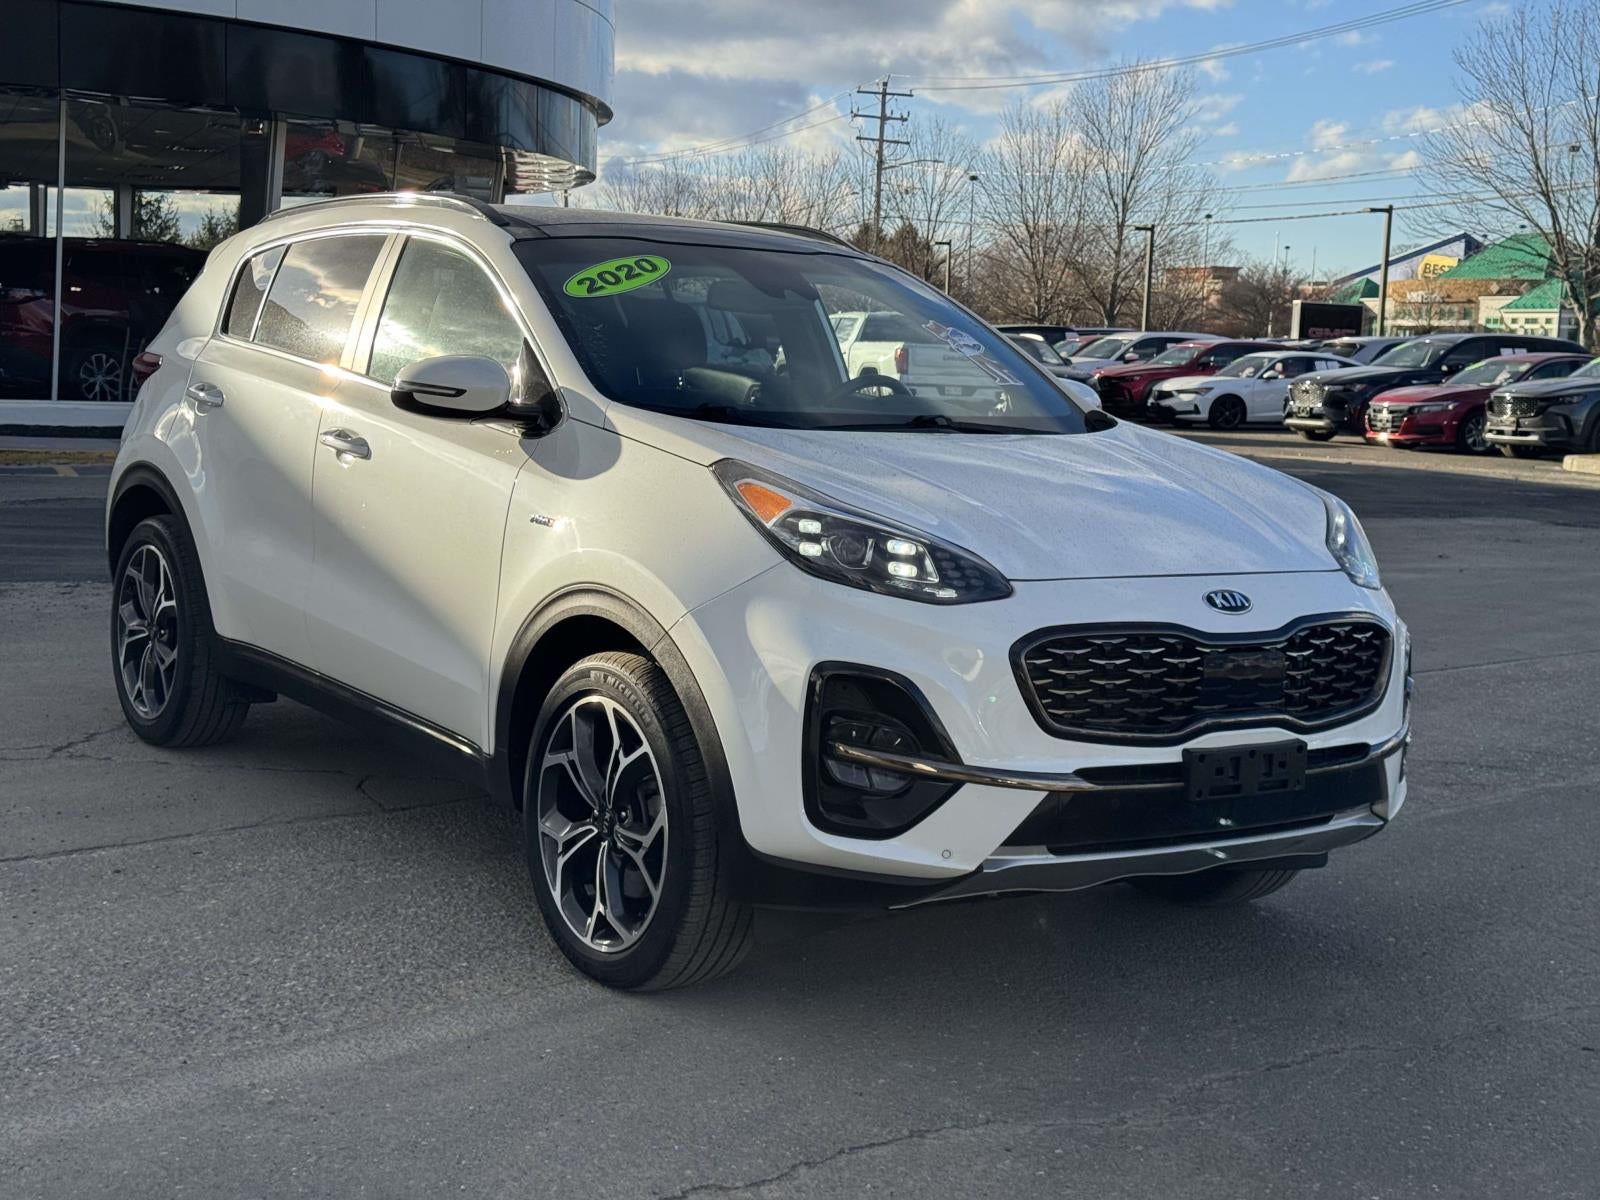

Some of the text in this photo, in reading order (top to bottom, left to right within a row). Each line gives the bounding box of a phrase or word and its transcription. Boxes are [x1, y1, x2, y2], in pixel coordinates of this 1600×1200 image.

[577, 258, 658, 294] 2020
[1423, 262, 1455, 276] BES
[1208, 591, 1250, 608] KIA
